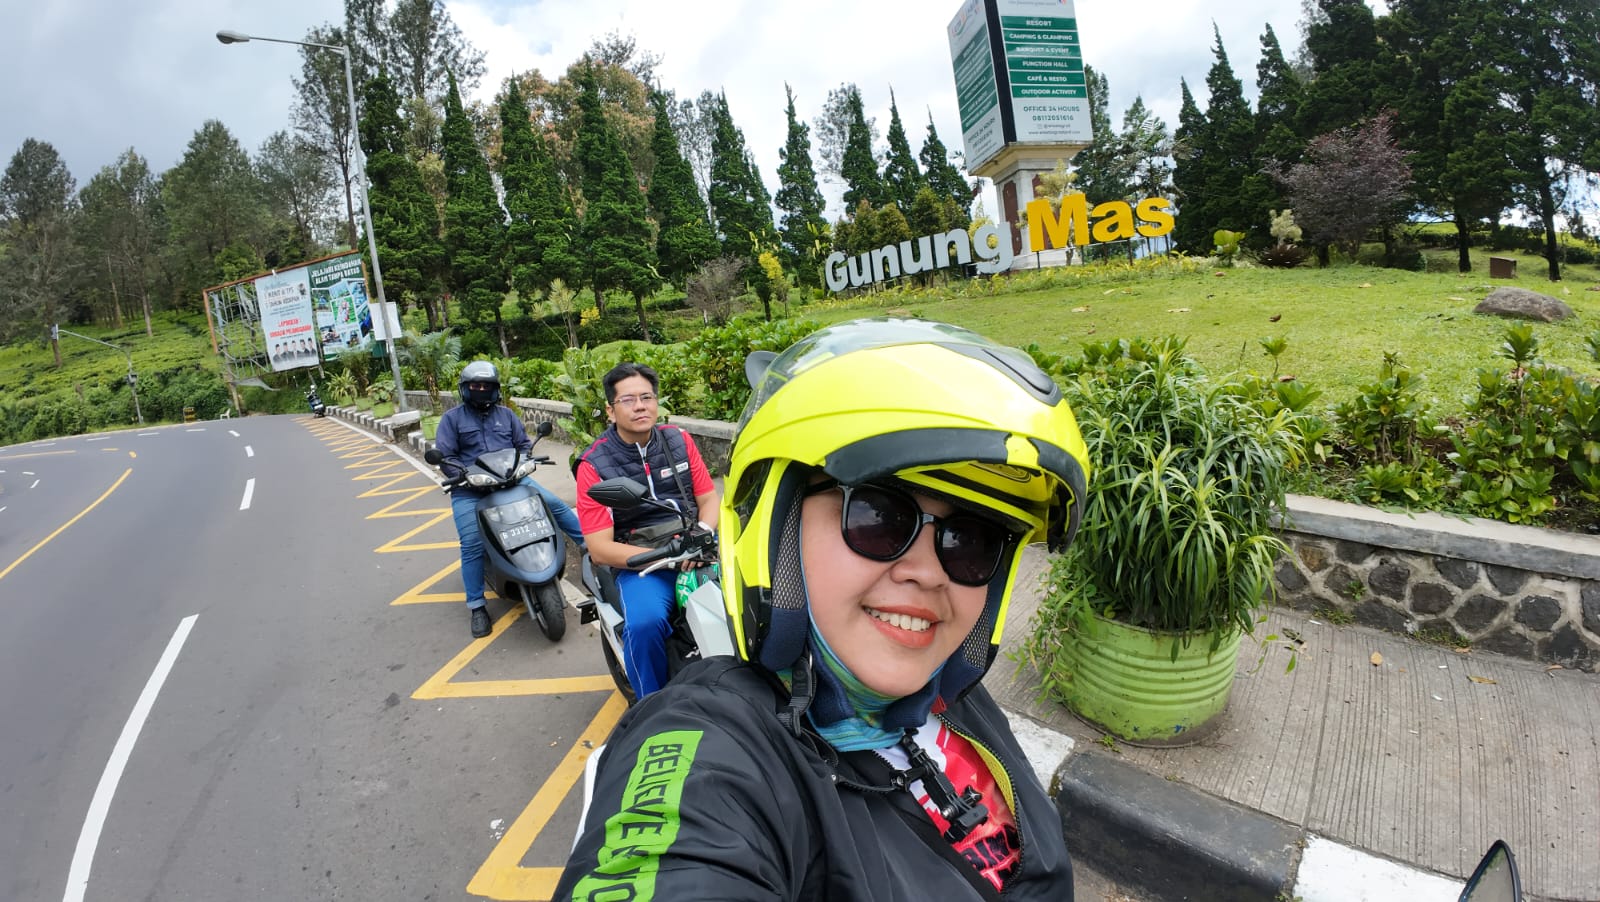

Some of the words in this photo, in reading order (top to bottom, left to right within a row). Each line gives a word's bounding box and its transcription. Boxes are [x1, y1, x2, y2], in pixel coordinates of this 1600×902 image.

[824, 221, 1014, 292] Gunung
[1026, 193, 1175, 253] Mas
[621, 743, 684, 840] BELIEVE
